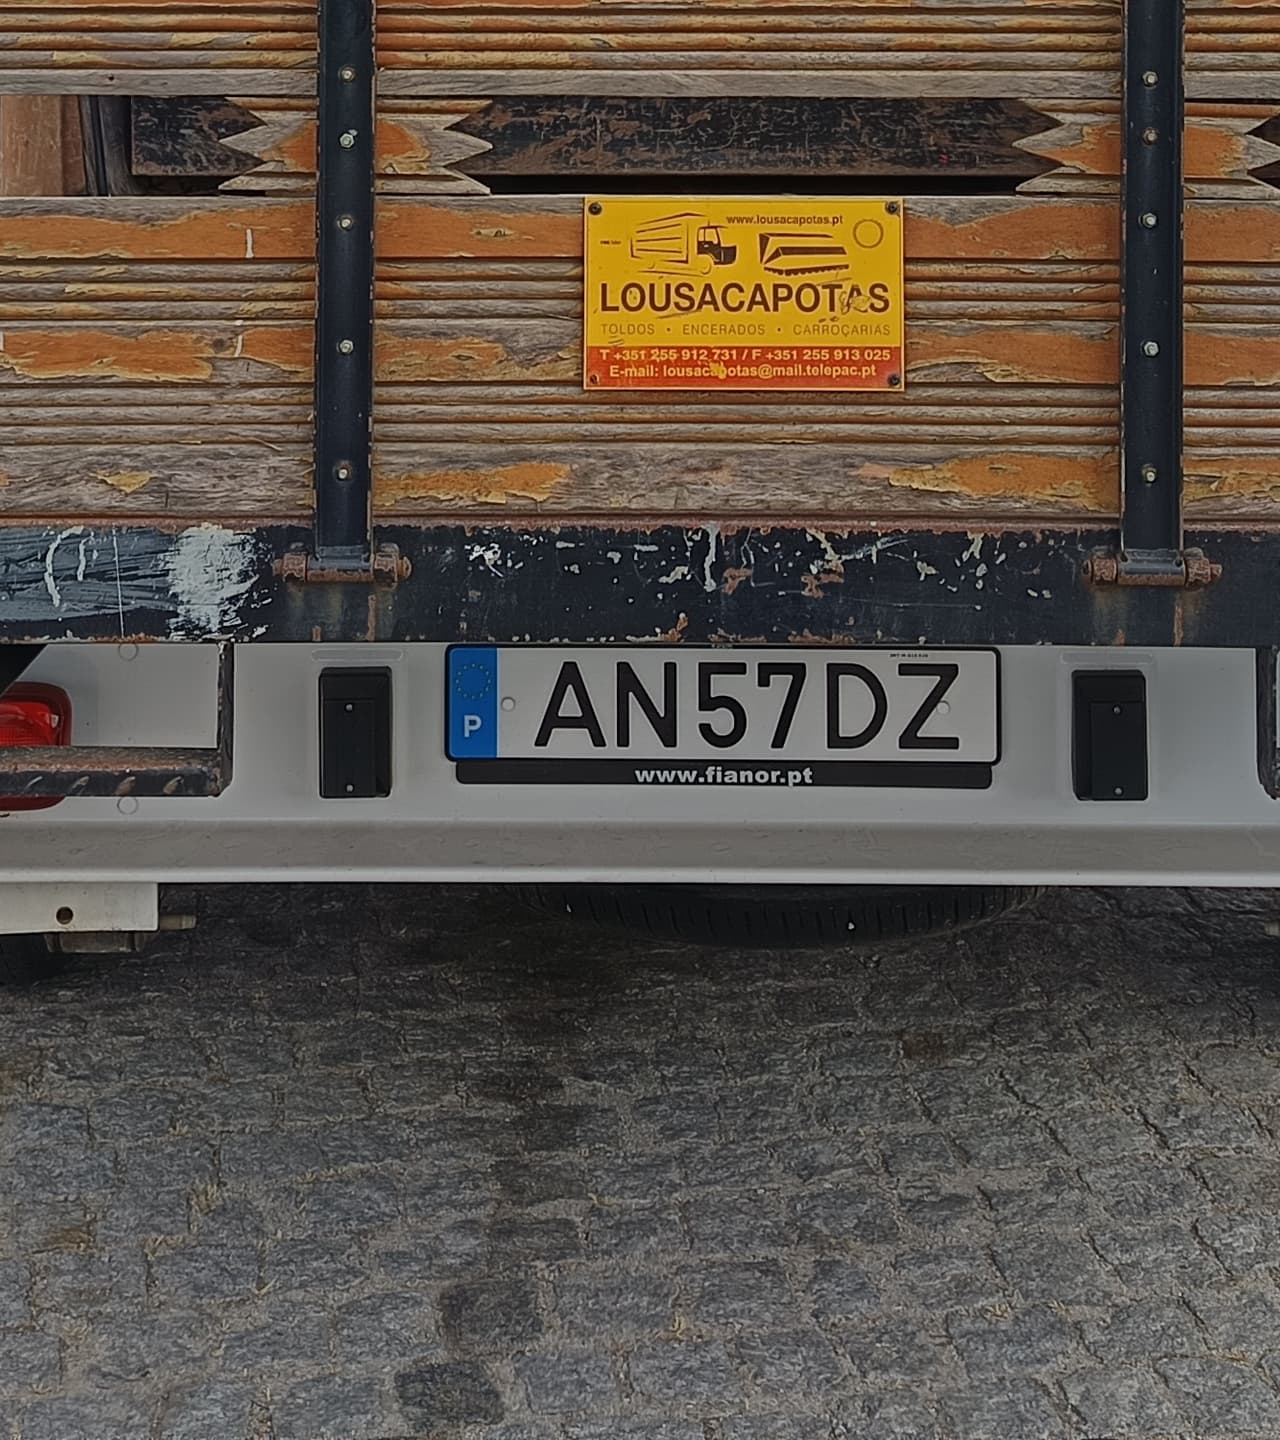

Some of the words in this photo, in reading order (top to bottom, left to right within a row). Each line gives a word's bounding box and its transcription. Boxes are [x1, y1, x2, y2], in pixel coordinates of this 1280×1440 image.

[725, 214, 844, 227] www.lousacapotas.pt
[600, 281, 891, 313] LOUSACAPOTAS
[601, 323, 656, 336] TOLDOS
[682, 323, 766, 336] ENCERADOS
[792, 323, 891, 337] CARROÇARIAS
[600, 348, 611, 361] T
[614, 348, 647, 361] +351
[650, 348, 678, 361] 255
[681, 348, 709, 361] 912
[712, 348, 738, 361] 731
[751, 348, 762, 361] F
[765, 348, 798, 361] +351
[802, 348, 830, 361] 255
[833, 348, 861, 361] 913
[864, 348, 891, 361] 025
[609, 364, 660, 378] E-mail:
[462, 714, 482, 738] P
[634, 766, 813, 788] www.fianor.pt
